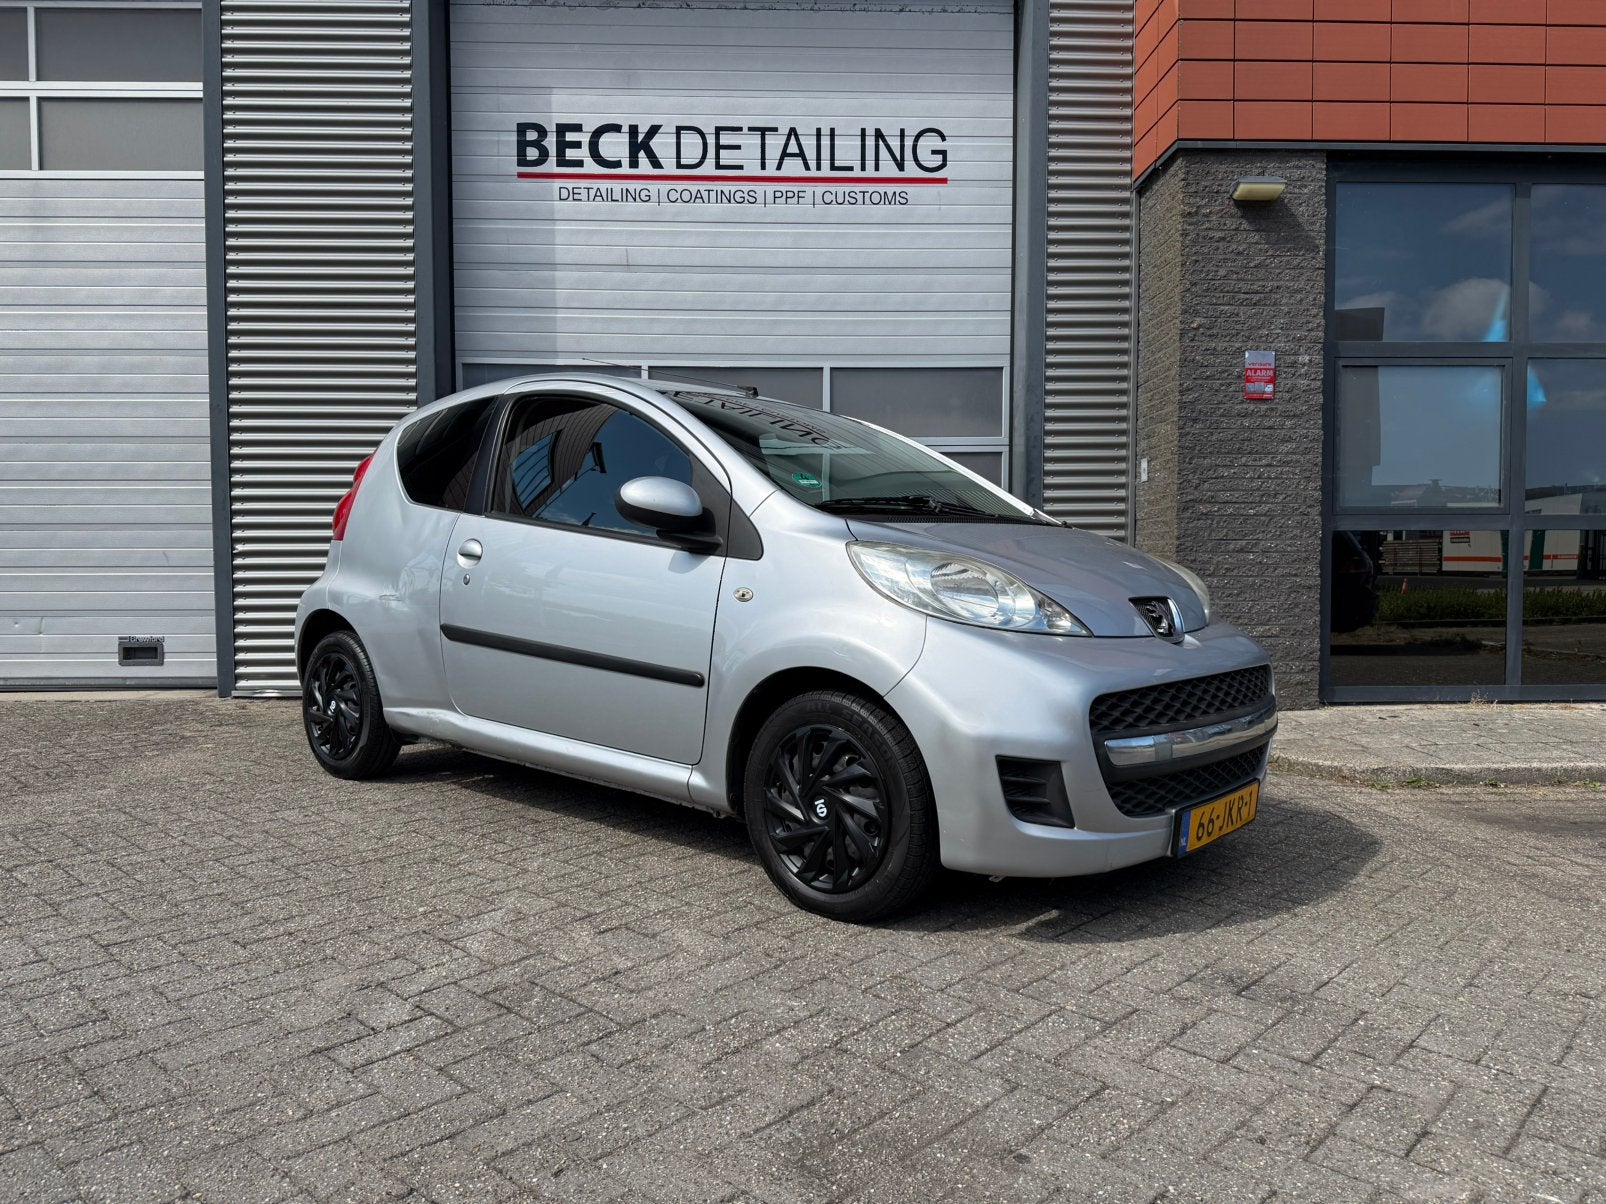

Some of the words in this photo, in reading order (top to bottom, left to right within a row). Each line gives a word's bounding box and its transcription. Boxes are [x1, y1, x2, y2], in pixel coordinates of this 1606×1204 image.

[558, 186, 651, 203] DETAILING
[666, 188, 758, 205] COATINGS
[773, 190, 807, 205] PPF
[821, 190, 909, 206] CUSTOMS
[1196, 790, 1253, 841] 66-JKR-1
